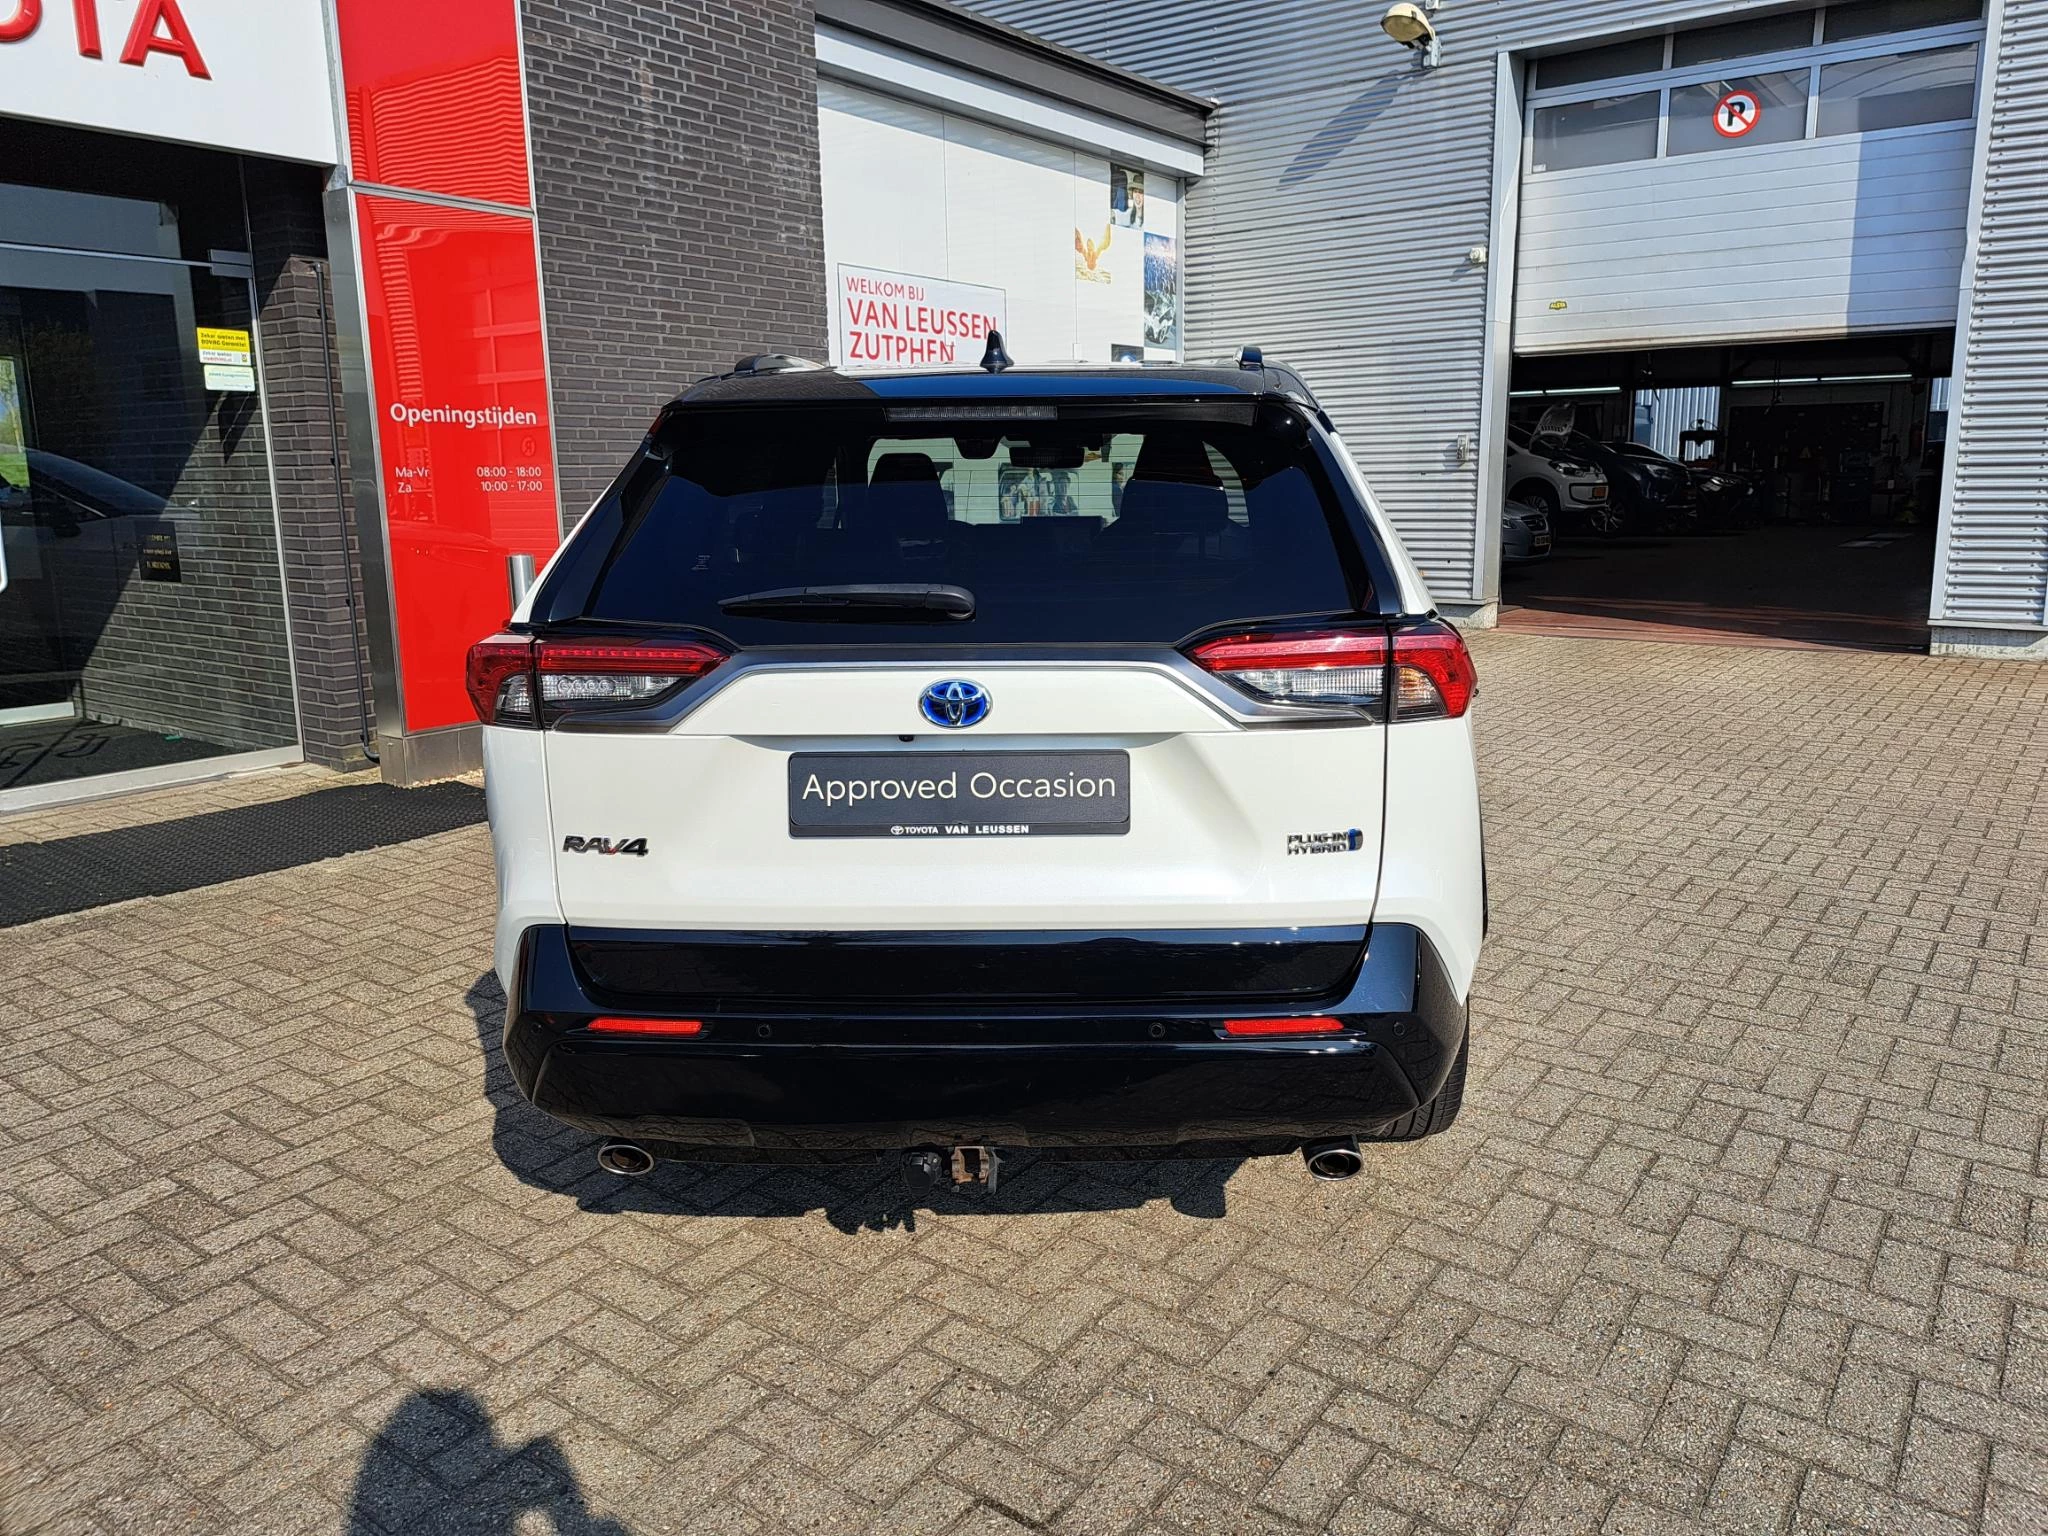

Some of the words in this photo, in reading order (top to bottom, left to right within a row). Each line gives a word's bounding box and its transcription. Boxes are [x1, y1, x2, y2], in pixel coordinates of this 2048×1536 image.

[846, 276, 905, 299] WELKOM
[908, 285, 925, 301] BIJ
[847, 297, 898, 330] VAN
[905, 305, 997, 340] LEUSSEN
[849, 331, 955, 364] ZUTPHEN
[390, 402, 537, 430] Openingstijden
[395, 466, 430, 479] Ma-Vr
[476, 466, 507, 478] 08:00
[516, 466, 542, 478] 18:00
[398, 481, 413, 494] Za
[481, 480, 508, 492] 10:00
[518, 480, 543, 492] 17:00
[802, 771, 957, 807] Approved
[970, 771, 1116, 799] Occasion
[905, 825, 939, 835] TOYOTA
[945, 825, 969, 835] VAN
[975, 825, 1030, 835] LEUSSEN
[1287, 832, 1349, 844] PLUG-IN
[562, 835, 649, 857] RAV4
[1287, 841, 1347, 855] HYBRID
